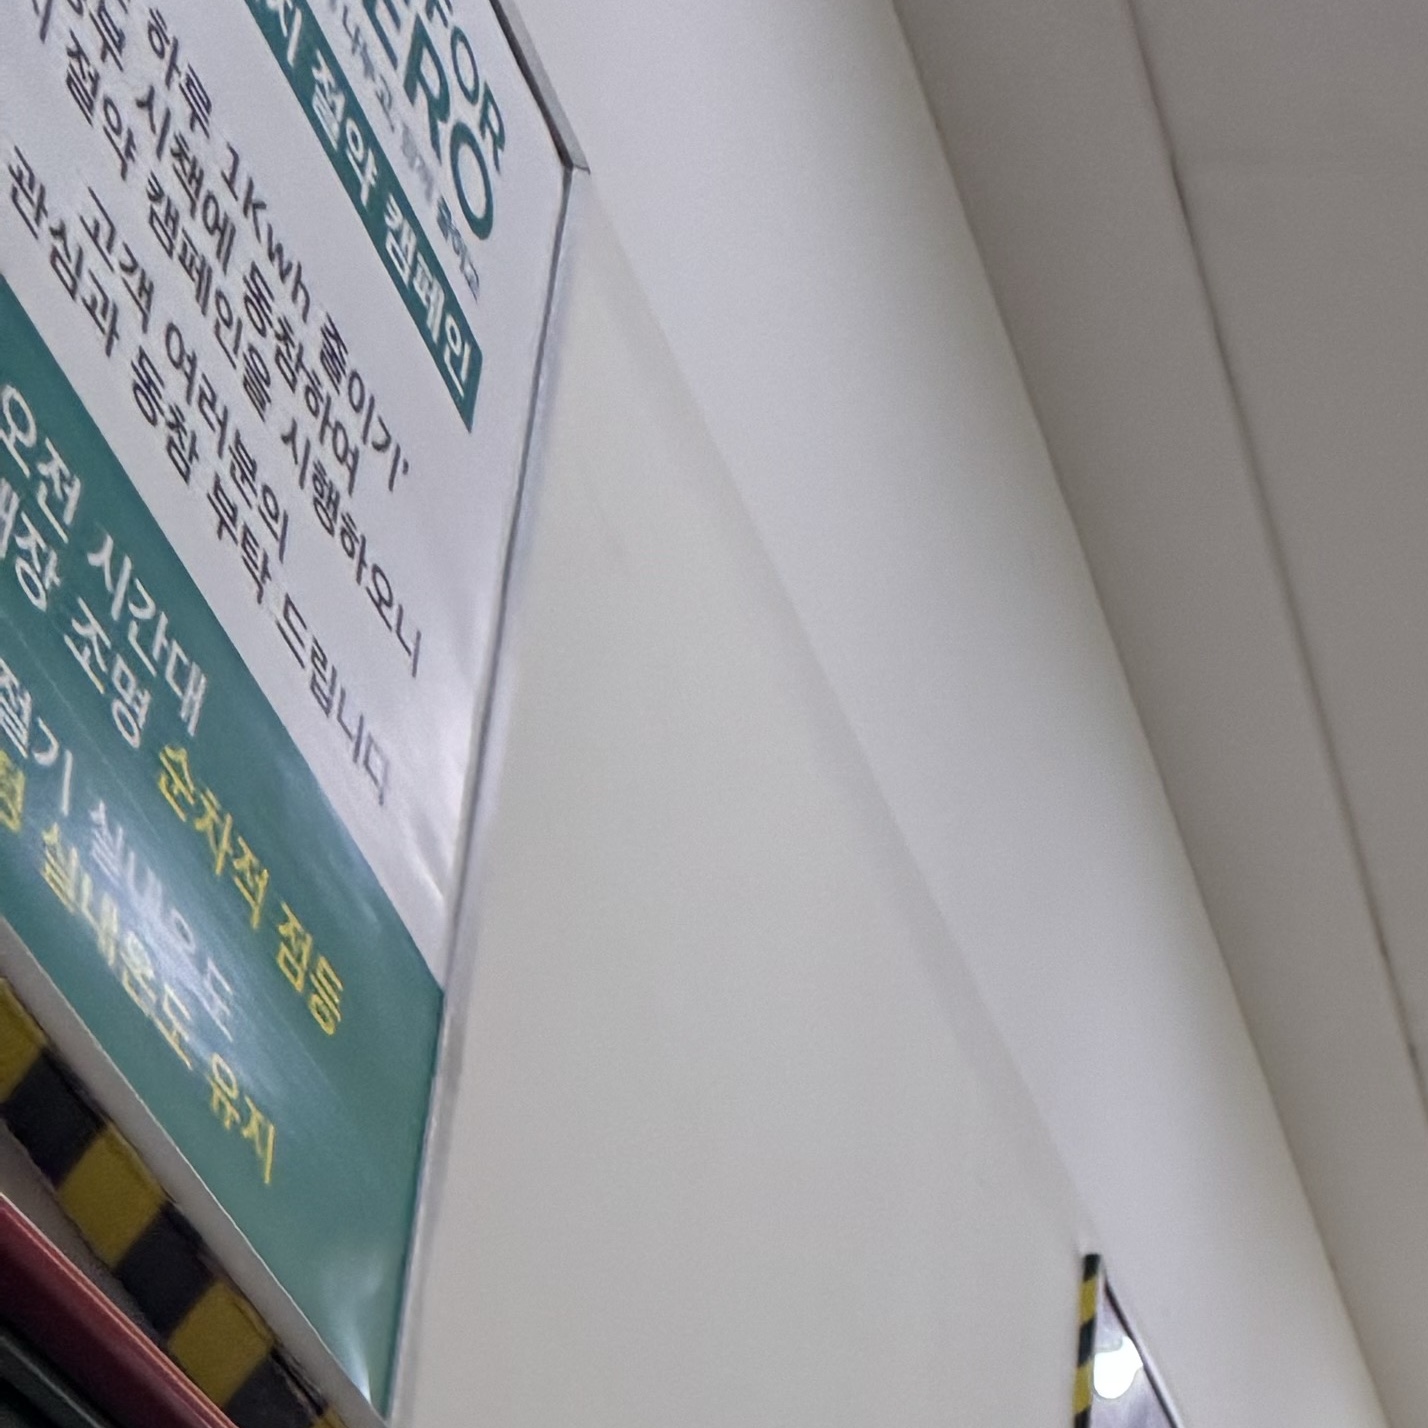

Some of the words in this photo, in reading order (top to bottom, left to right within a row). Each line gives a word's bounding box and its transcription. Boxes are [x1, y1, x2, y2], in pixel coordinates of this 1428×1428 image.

[66, 0, 126, 72] 부
[136, 84, 236, 277] 시책에
[243, 261, 359, 497] 동참하여
[148, 8, 212, 139] 하루
[311, 47, 378, 208] 절약
[383, 193, 471, 399] 캠페인
[8, 145, 119, 357] 관심과
[131, 346, 199, 486] 동참
[207, 472, 272, 604] 부탁
[276, 593, 389, 806] 드립니다
[66, 27, 137, 181] 절약
[147, 171, 272, 423] 캠페인을
[281, 418, 421, 678] 시행하오니
[79, 186, 154, 334] 고객
[165, 322, 288, 564] 여러분의
[0, 384, 81, 544] 오전
[87, 533, 206, 737] 시간대
[64, 596, 151, 748] 조명
[158, 744, 269, 929] 순차적
[277, 901, 343, 1035] 점등
[208, 1051, 276, 1184] 유지
